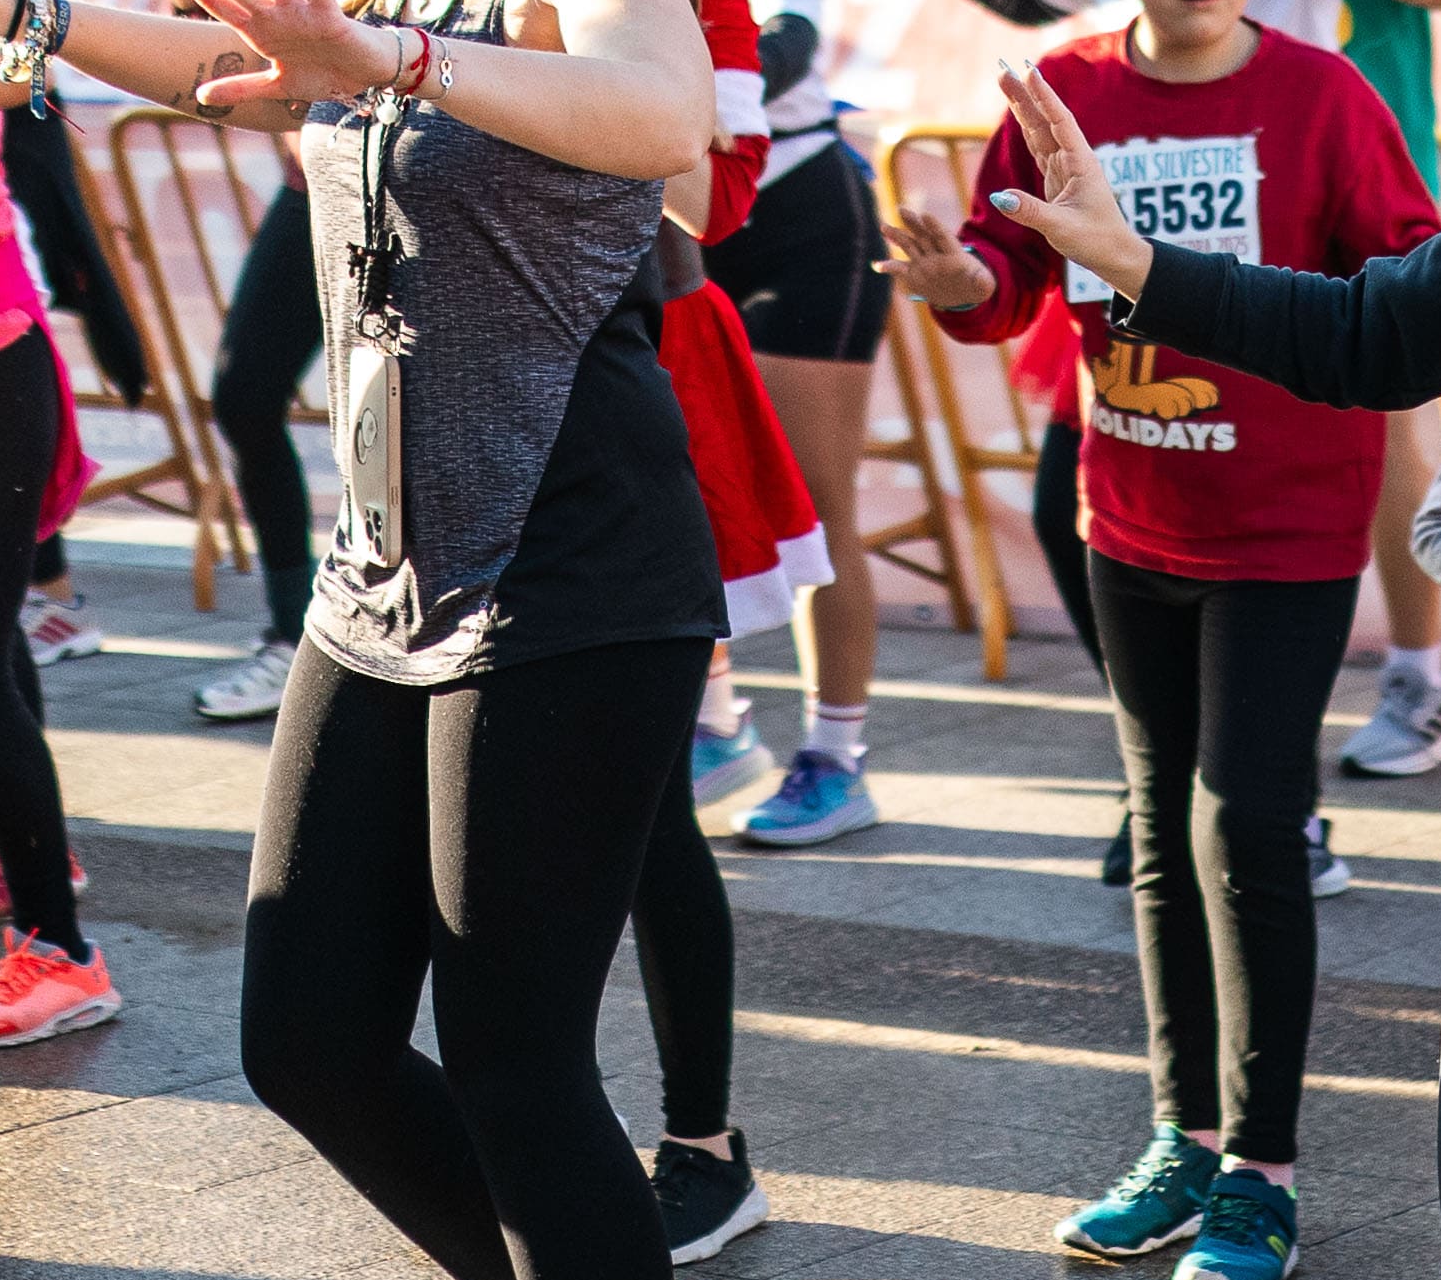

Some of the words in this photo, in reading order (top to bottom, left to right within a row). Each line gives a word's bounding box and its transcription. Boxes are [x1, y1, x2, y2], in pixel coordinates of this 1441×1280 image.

[1112, 154, 1146, 184] SAN
[1153, 146, 1245, 180] SILVESTRE
[1134, 179, 1246, 236] 5532
